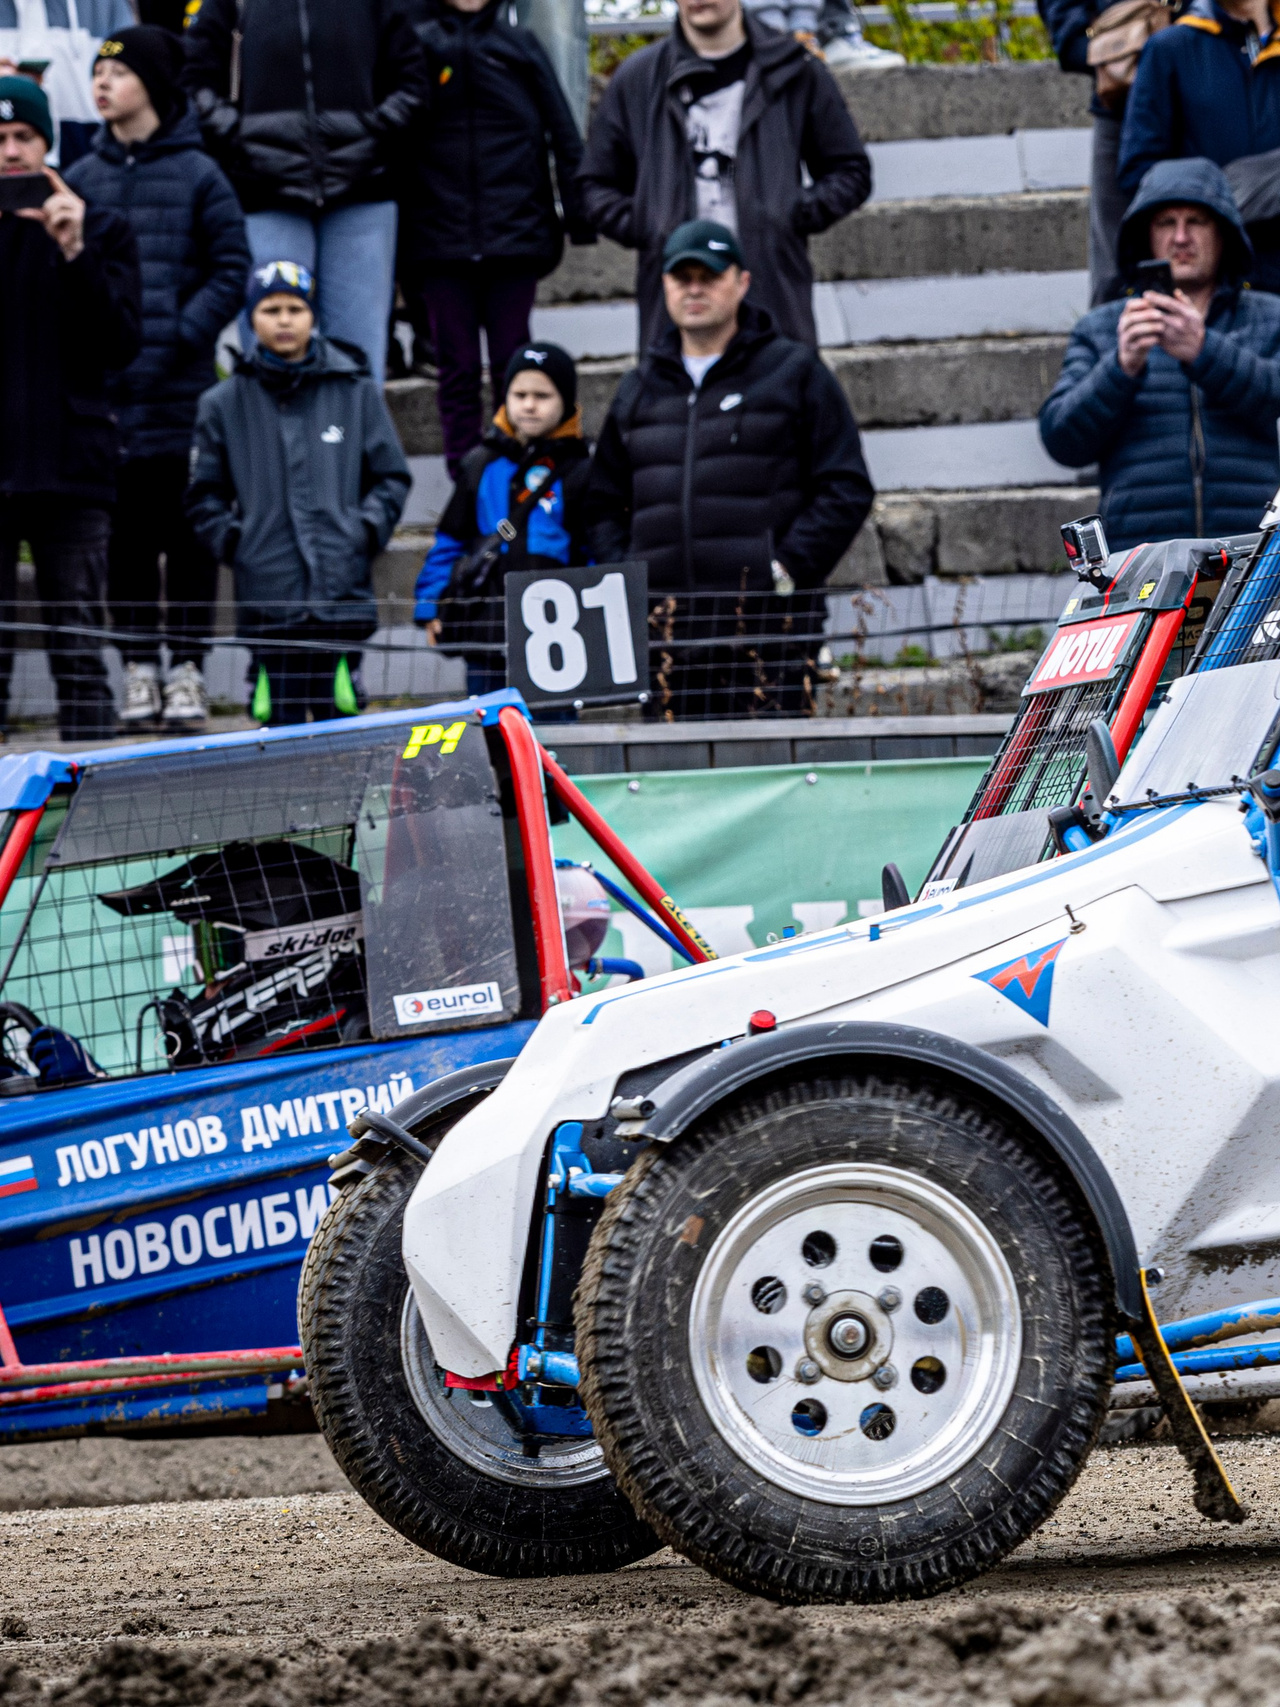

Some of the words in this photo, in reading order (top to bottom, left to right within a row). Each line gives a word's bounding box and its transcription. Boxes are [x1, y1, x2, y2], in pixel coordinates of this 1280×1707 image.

[520, 572, 638, 693] 81
[1035, 623, 1129, 683] MOTUL
[402, 721, 467, 759] P1
[426, 985, 494, 1011] eurol
[55, 1115, 229, 1188] ЛОГУНОВ
[69, 1182, 340, 1289] НОВОСИБИ
